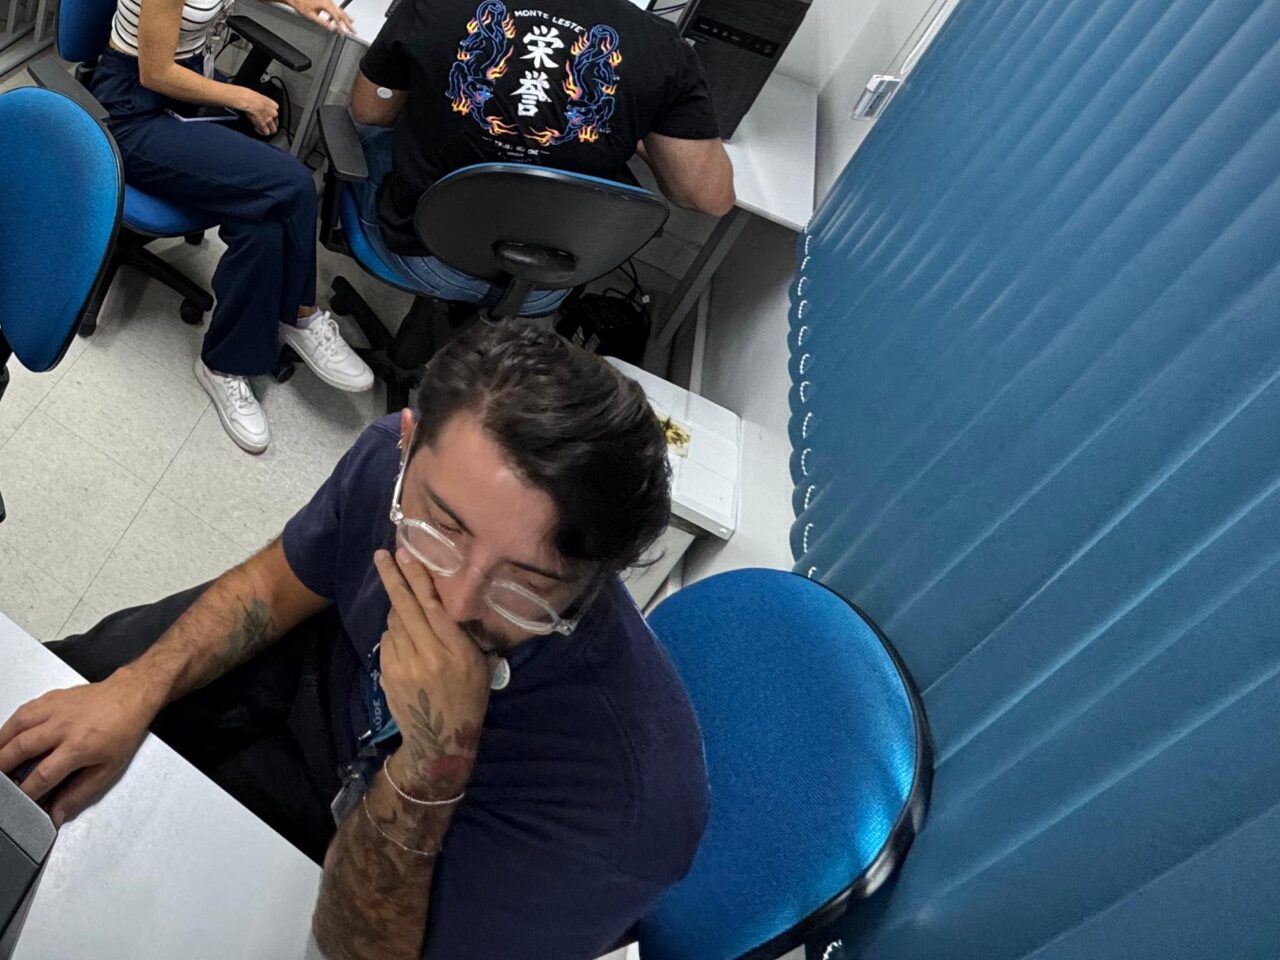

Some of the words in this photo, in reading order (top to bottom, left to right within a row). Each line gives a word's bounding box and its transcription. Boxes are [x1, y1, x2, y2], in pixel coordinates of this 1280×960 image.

[514, 9, 549, 20] MONTE
[552, 16, 583, 33] LESTE
[510, 25, 565, 117] 栄誉
